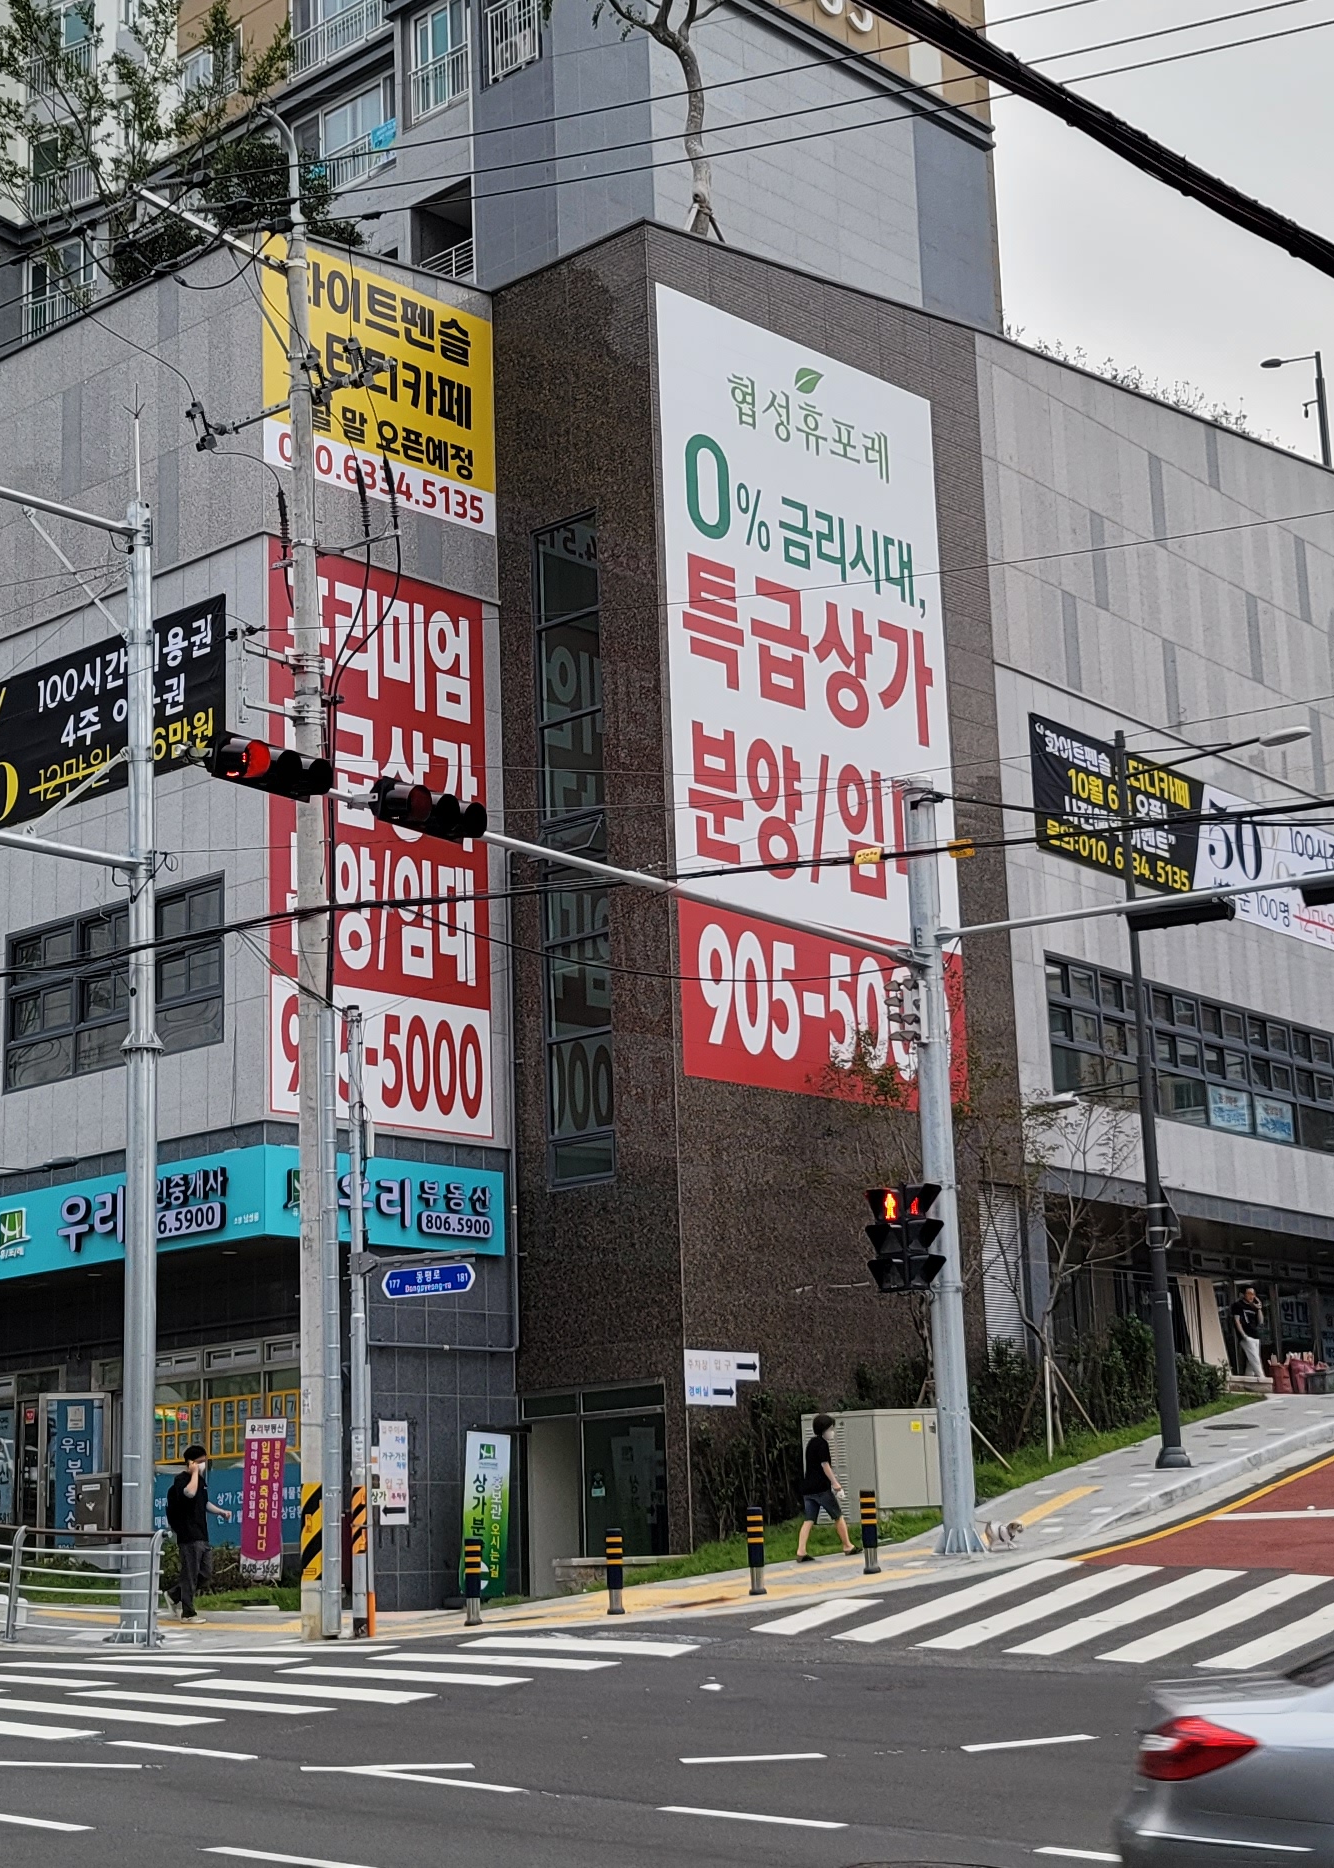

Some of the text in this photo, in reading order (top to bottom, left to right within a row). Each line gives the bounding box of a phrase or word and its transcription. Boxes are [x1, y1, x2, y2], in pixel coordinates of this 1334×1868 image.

[342, 405, 367, 445] 말
[376, 419, 474, 481] 오픈예정
[726, 373, 890, 485] 협성휴포레
[279, 431, 484, 524] 00.6334.5135
[685, 433, 771, 553] 0%
[682, 552, 934, 748] 특급상가
[60, 705, 102, 748] 4주
[1067, 768, 1105, 806] 10월
[155, 1165, 228, 1210] 인중개사
[421, 1179, 492, 1213] 부동산
[57, 1185, 126, 1253] 우리
[425, 1213, 491, 1236] 806.5900
[388, 1270, 469, 1290] 177 동평로 181
[60, 1437, 91, 1457] 우리
[249, 1424, 284, 1435] 우리부동산
[370, 1490, 387, 1503] 상가
